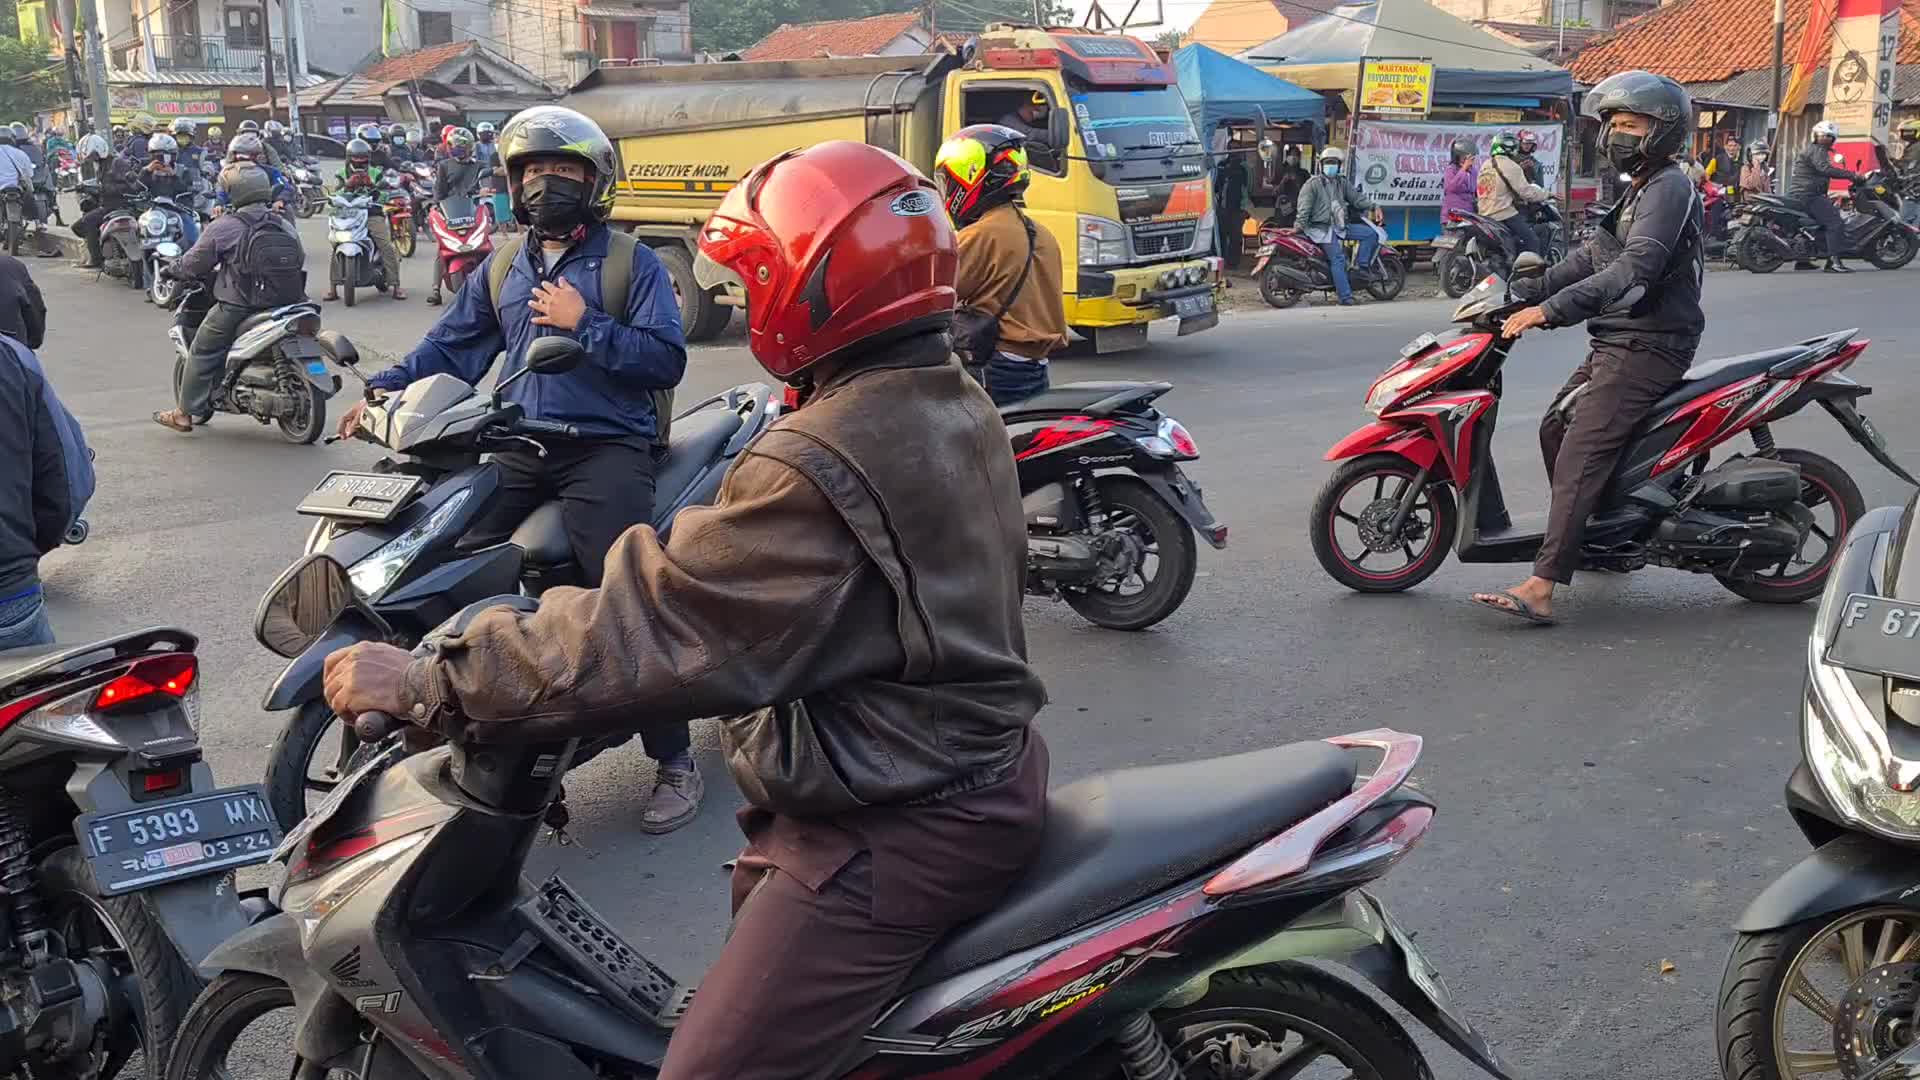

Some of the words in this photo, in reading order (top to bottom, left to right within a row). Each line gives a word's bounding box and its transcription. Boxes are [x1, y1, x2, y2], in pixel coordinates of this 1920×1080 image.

[1377, 64, 1418, 73] MARTABAK
[628, 164, 693, 177] EXECUTIVE
[692, 165, 730, 177] MUDA
[1390, 177, 1428, 189] Sedia
[1398, 190, 1442, 201] Pesanan
[1402, 389, 1433, 407] HONDA
[1846, 602, 1869, 628] F
[1883, 608, 1920, 639] 67
[93, 826, 113, 853] F
[127, 808, 200, 845] 5393
